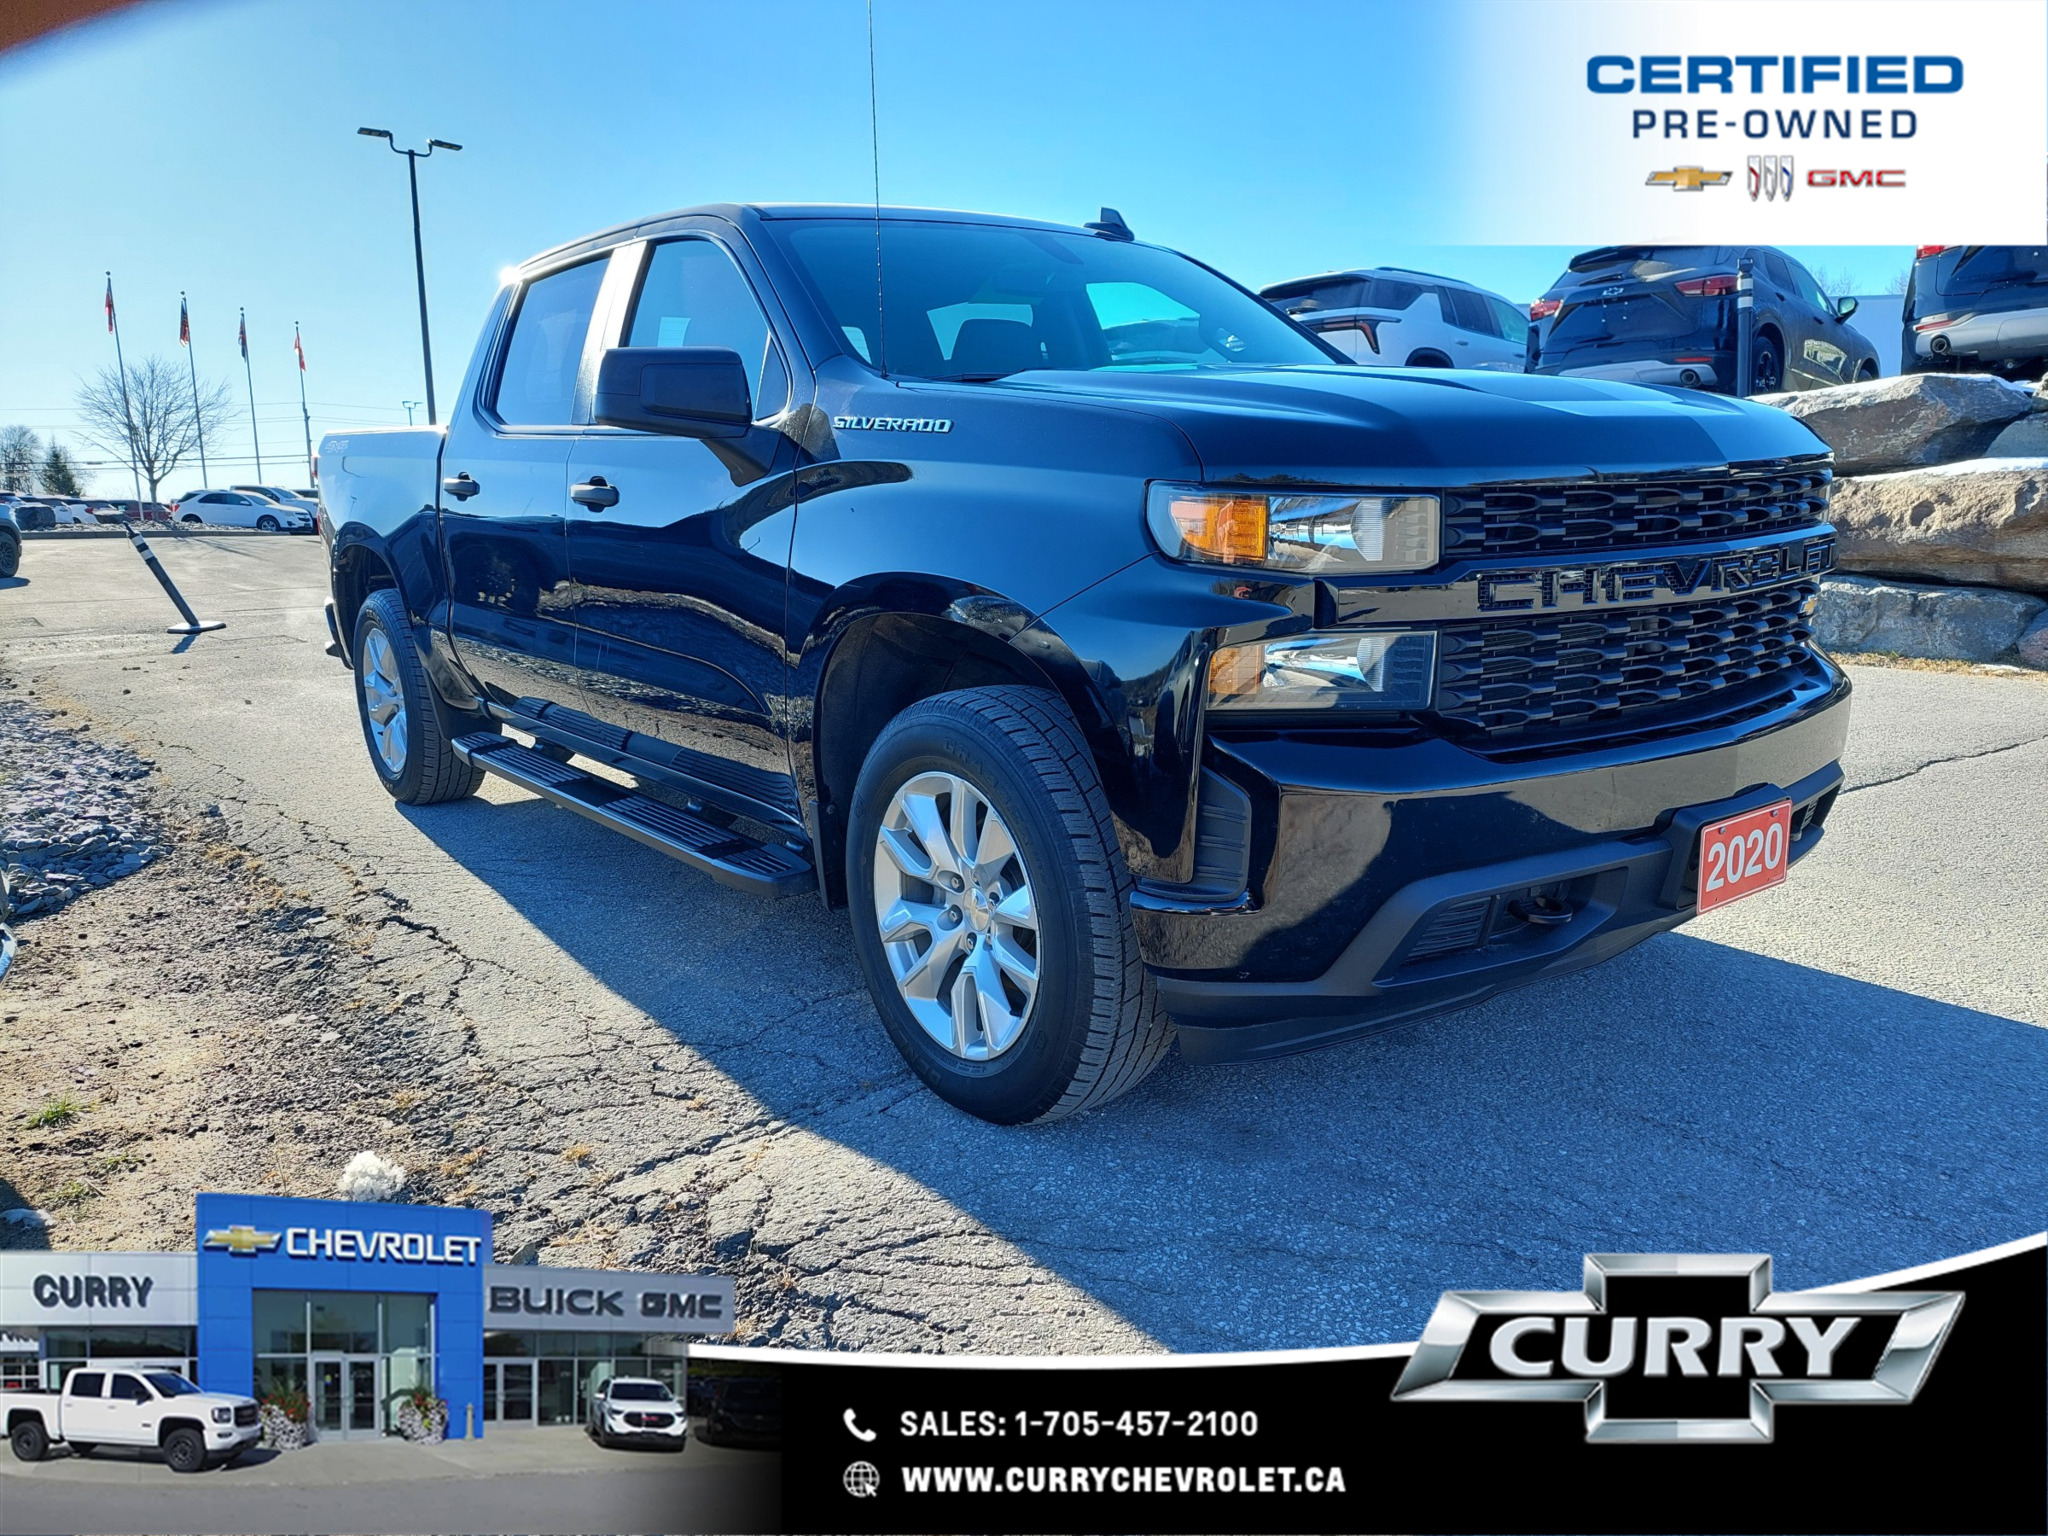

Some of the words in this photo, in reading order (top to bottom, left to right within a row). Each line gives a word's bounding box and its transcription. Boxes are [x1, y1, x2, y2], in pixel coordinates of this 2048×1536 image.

[833, 416, 953, 433] SILVERADO
[1478, 537, 1837, 612] CHEVROLET
[1706, 822, 1783, 892] 2020
